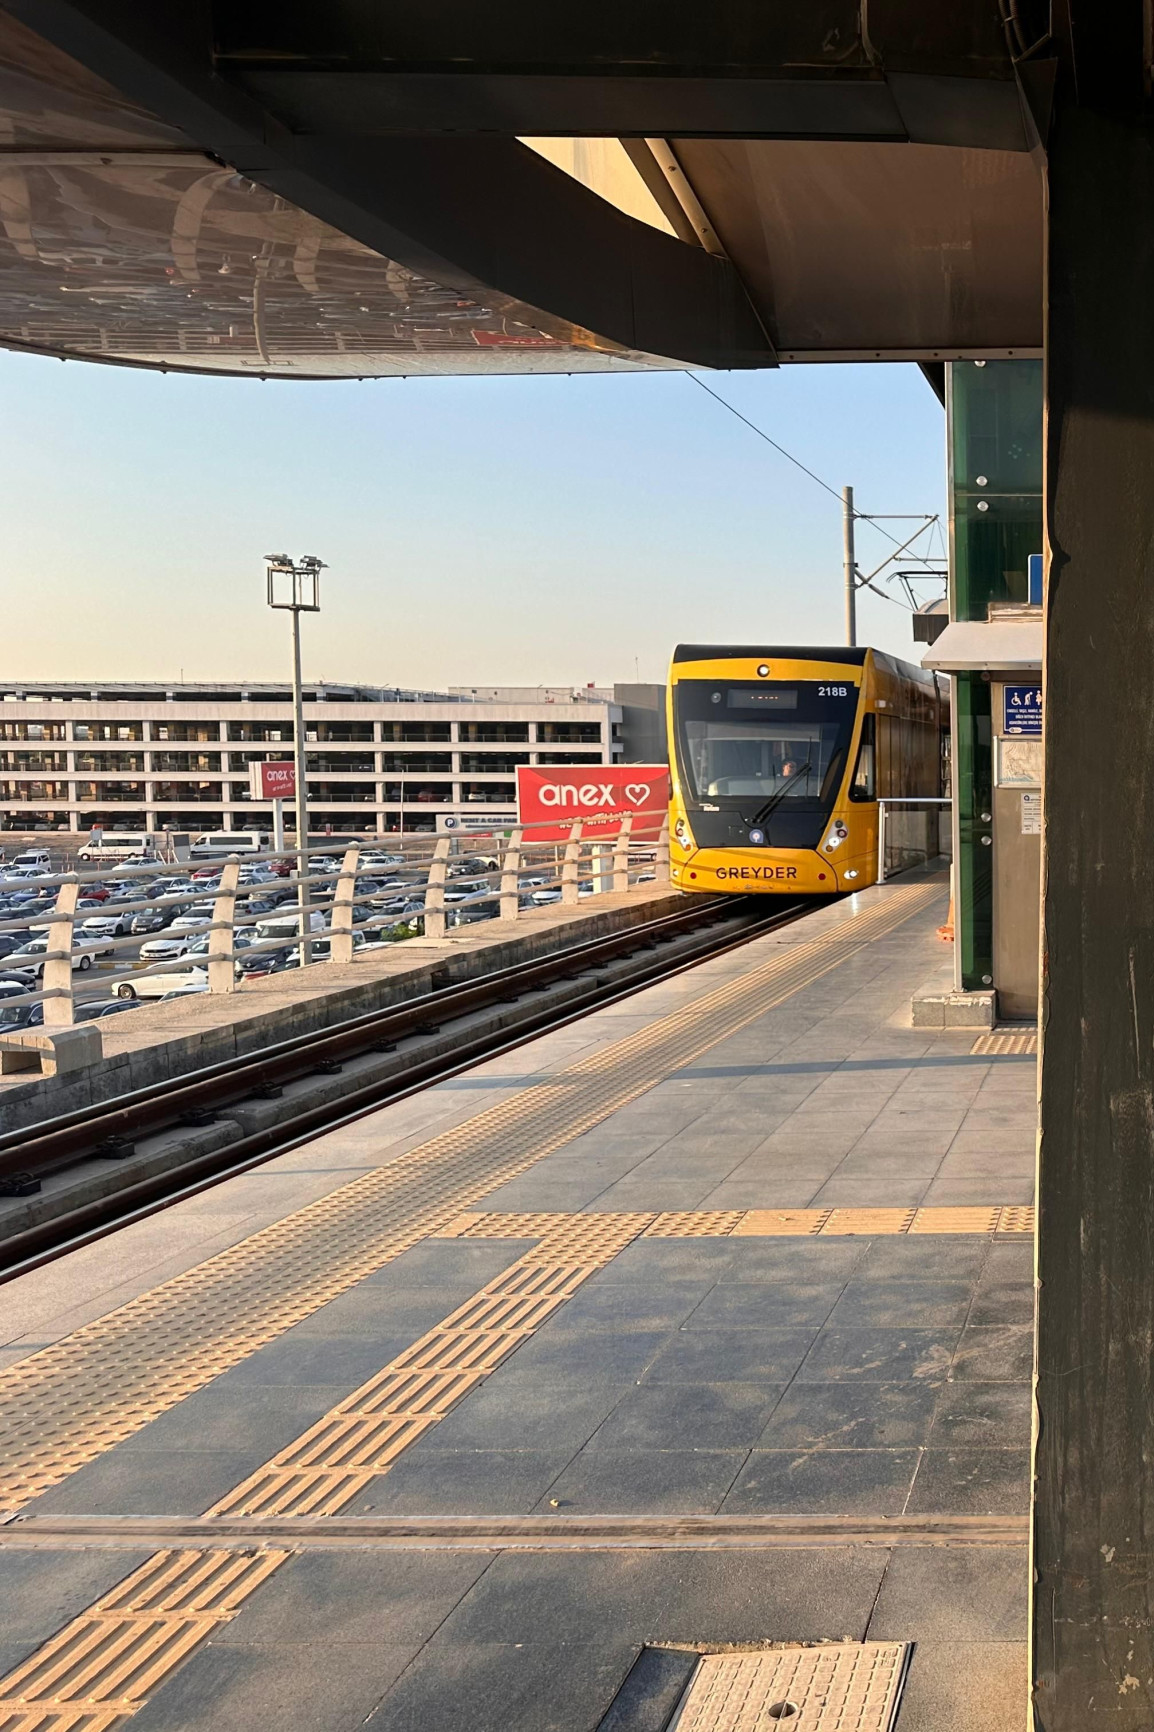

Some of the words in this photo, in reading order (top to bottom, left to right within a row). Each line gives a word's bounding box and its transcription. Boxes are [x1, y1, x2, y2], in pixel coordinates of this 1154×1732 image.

[818, 686, 848, 697] 218B
[266, 770, 288, 781] anex
[538, 784, 616, 806] anex
[715, 866, 797, 880] GREYDER
